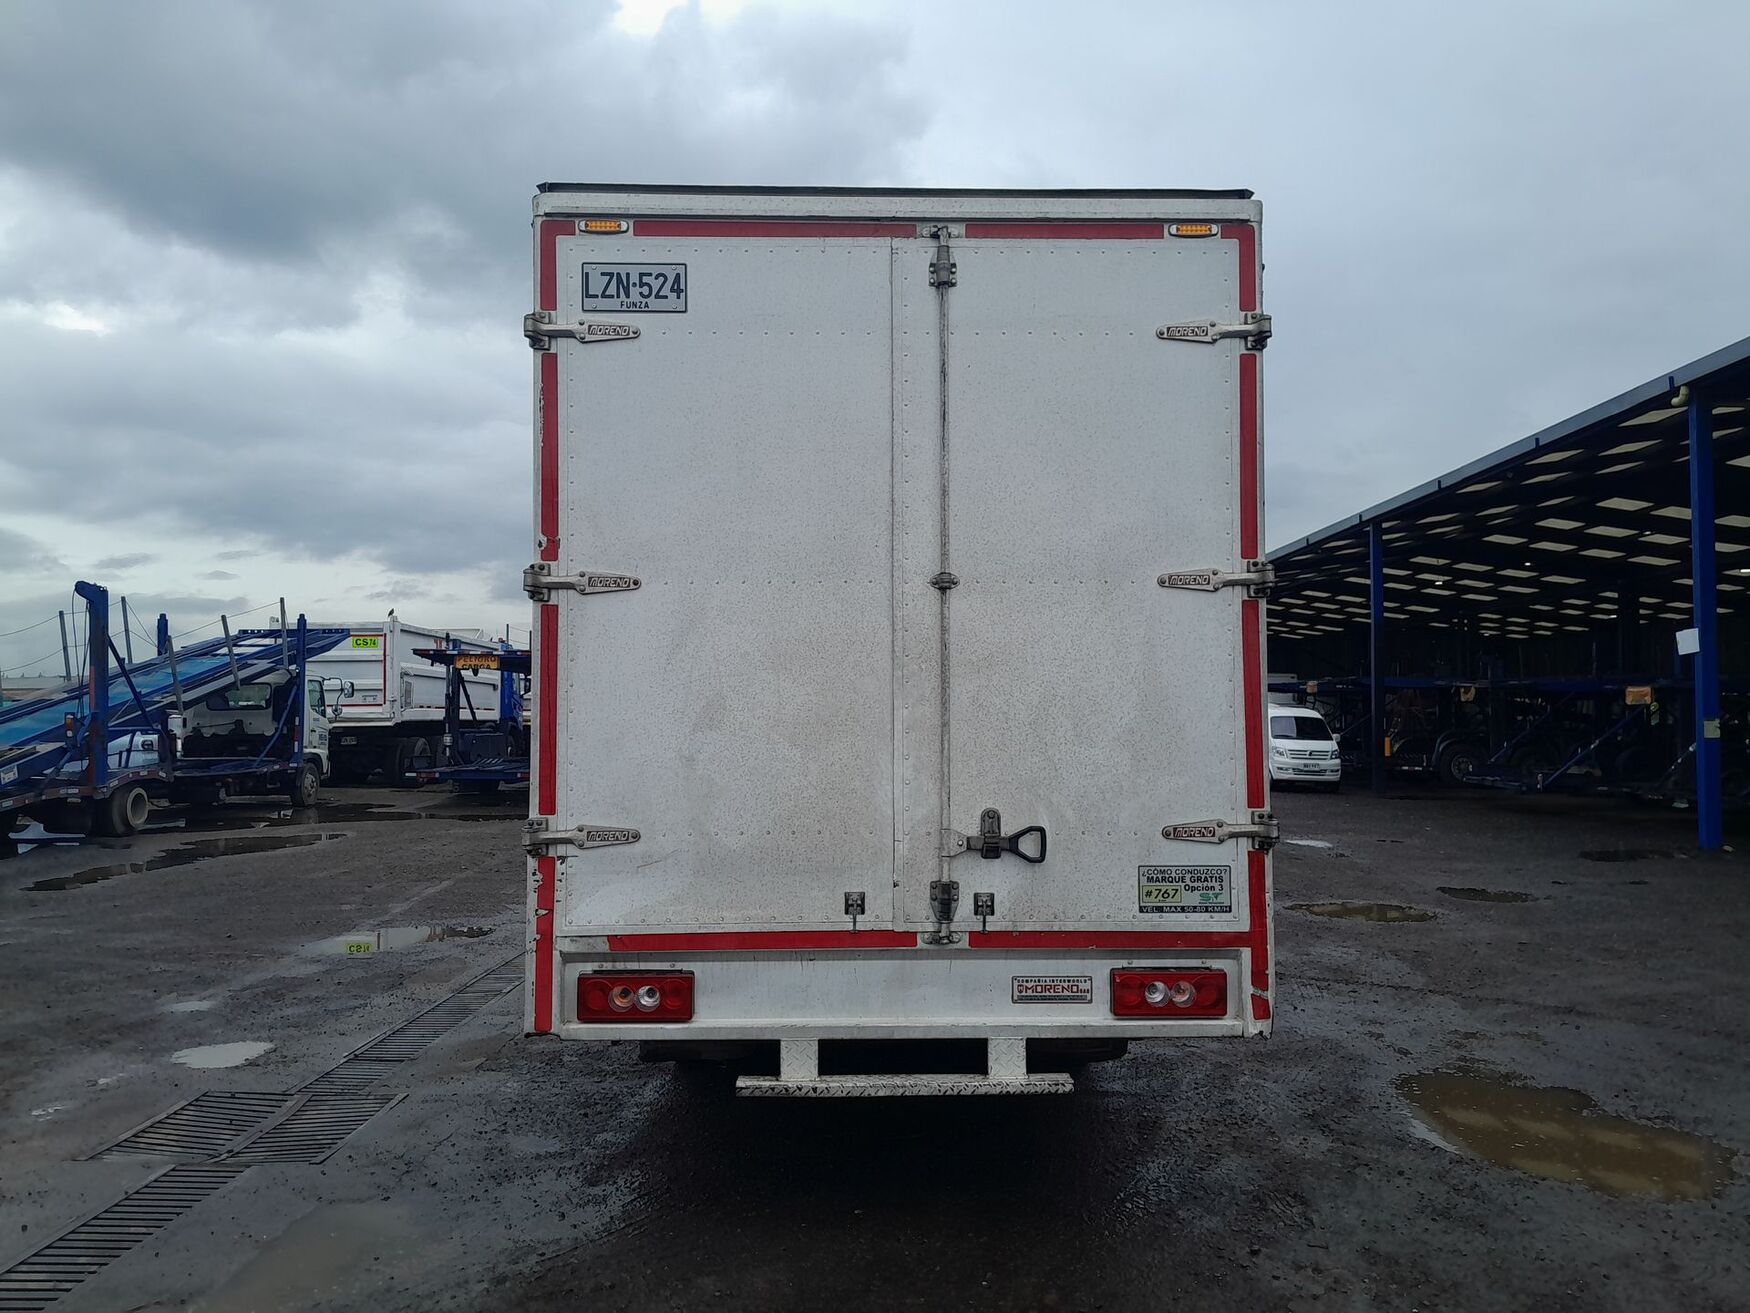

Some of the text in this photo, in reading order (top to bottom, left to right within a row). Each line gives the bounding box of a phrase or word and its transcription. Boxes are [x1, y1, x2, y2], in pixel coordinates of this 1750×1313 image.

[620, 300, 650, 309] FUNZA
[589, 325, 630, 336] MORENO
[1167, 327, 1207, 337] MORENO
[589, 577, 630, 588] MORENO
[1169, 575, 1209, 585] MORENO
[587, 831, 629, 841] MORENO
[1174, 827, 1215, 838] MORENO
[1174, 868, 1228, 876] CONDUZCO?
[1146, 875, 1224, 884] MARQUE GRATIS
[1183, 883, 1224, 893] Opción 3
[1144, 888, 1179, 899] #767
[1025, 984, 1079, 994] MORENO
